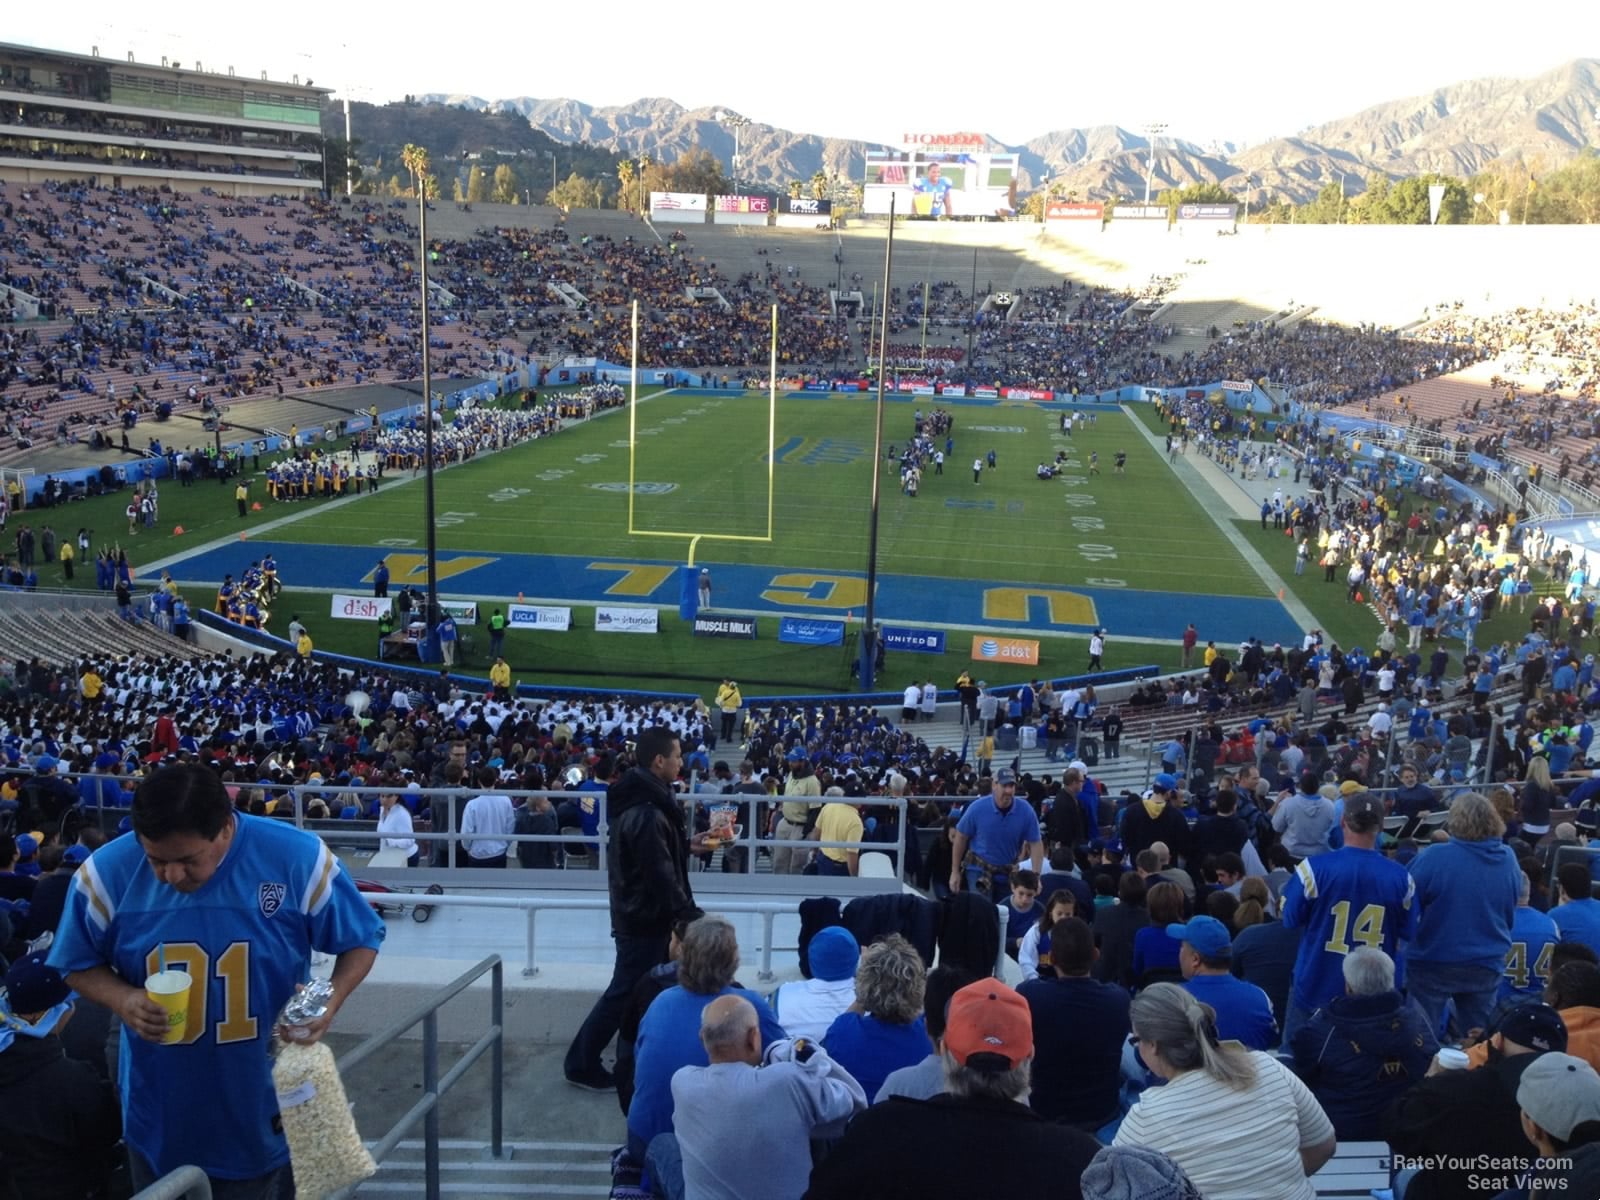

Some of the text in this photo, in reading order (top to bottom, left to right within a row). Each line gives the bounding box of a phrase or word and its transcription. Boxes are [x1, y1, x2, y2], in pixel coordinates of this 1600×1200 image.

[903, 133, 985, 145] HONDA
[750, 201, 767, 211] ICE
[1060, 208, 1098, 216] State Farm
[997, 293, 1009, 304] 25
[1223, 381, 1251, 391] HONDA
[1077, 543, 1118, 559] 10
[343, 599, 378, 617] dish
[514, 612, 567, 624] UCLA Health
[695, 620, 752, 634] MUSCLE MILK
[887, 635, 925, 645] UNITED
[1001, 645, 1031, 659] at&t
[1108, 724, 1118, 737] 17
[262, 884, 285, 900] PAC
[264, 900, 277, 911] 12
[1325, 900, 1386, 954] 14
